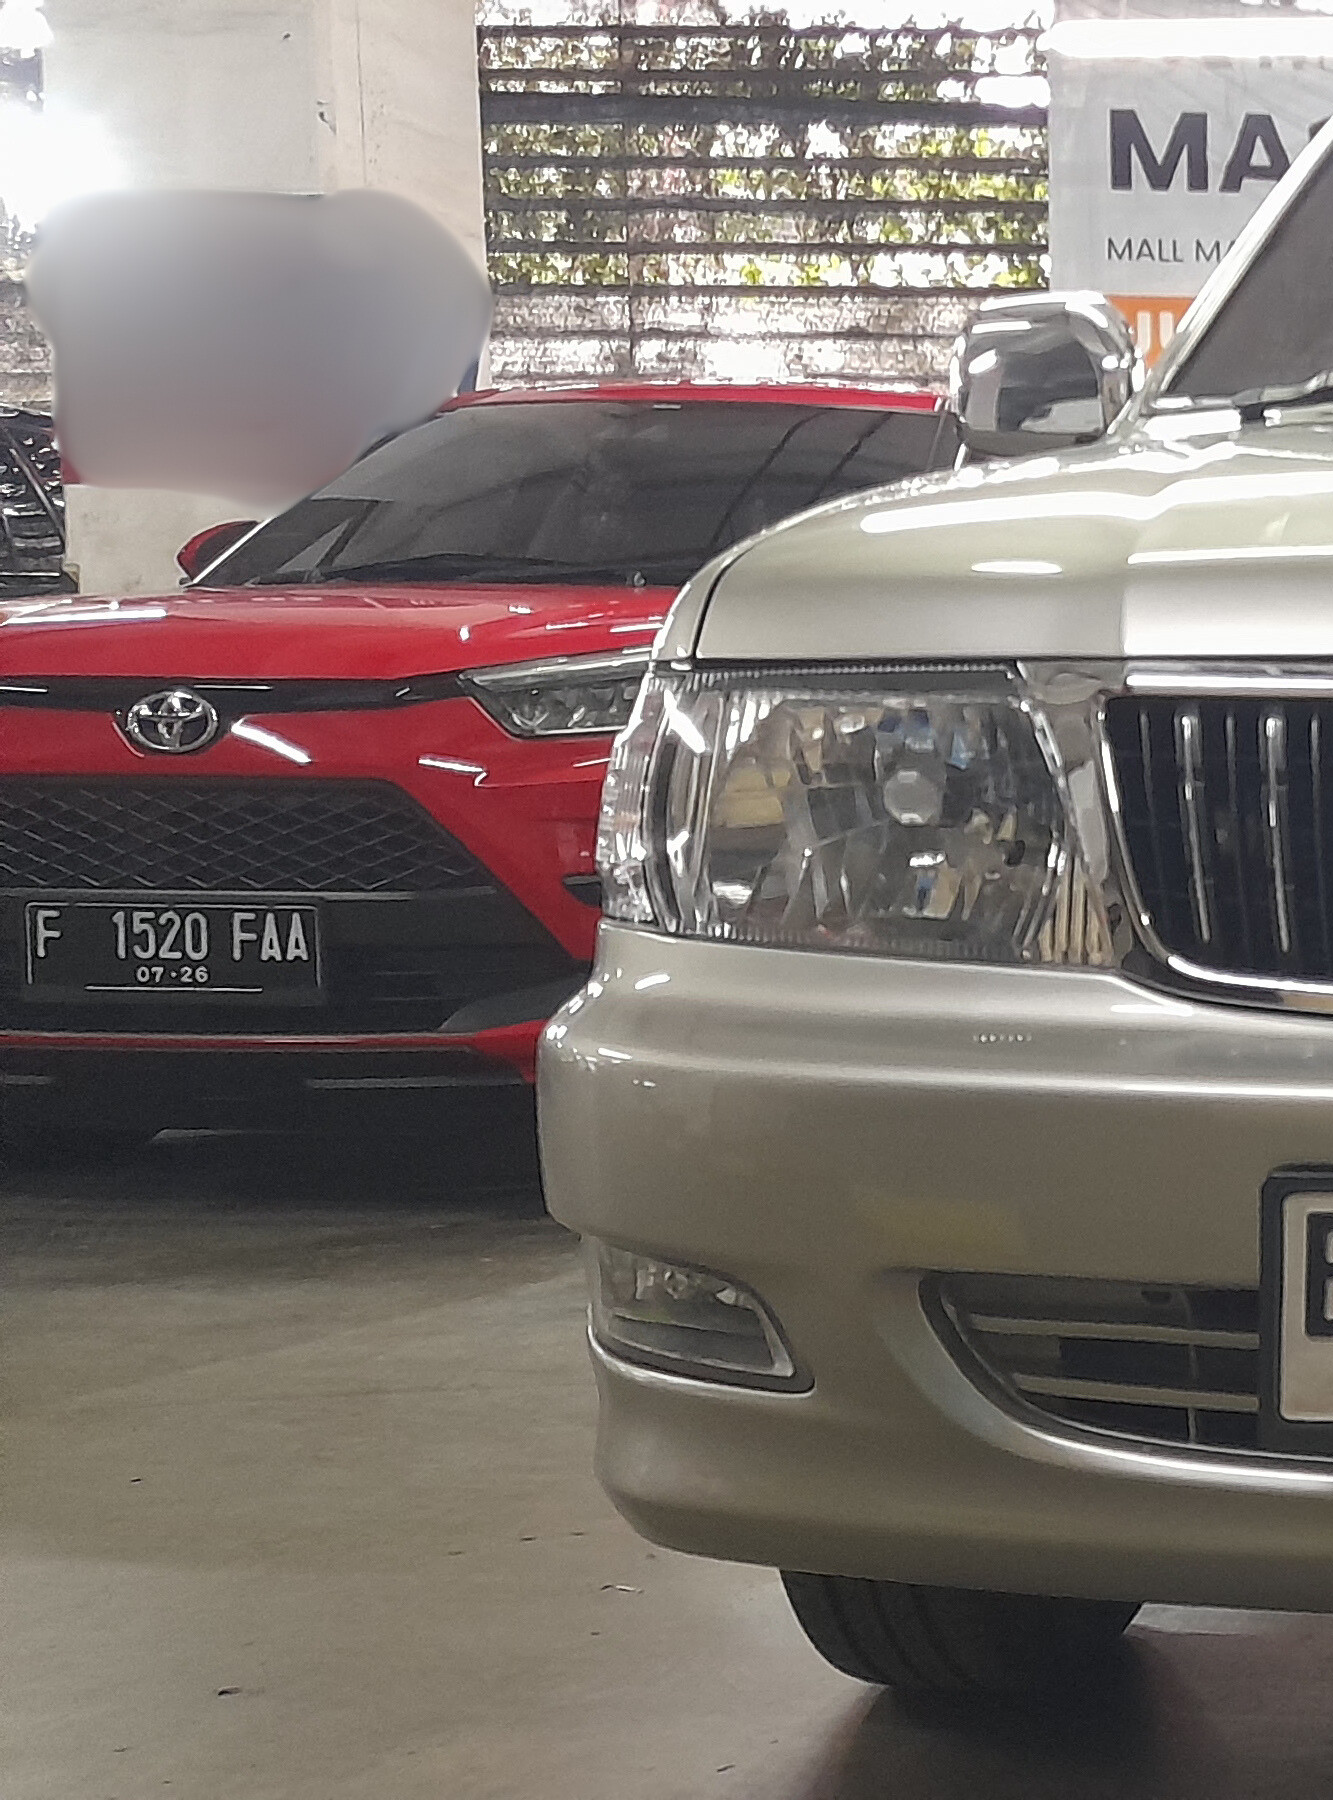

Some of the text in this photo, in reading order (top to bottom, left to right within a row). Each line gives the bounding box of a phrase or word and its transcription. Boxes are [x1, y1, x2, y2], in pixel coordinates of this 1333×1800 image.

[1110, 108, 1330, 193] MA
[1107, 236, 1237, 263] MALL M
[36, 909, 310, 962] F 1520 FAA
